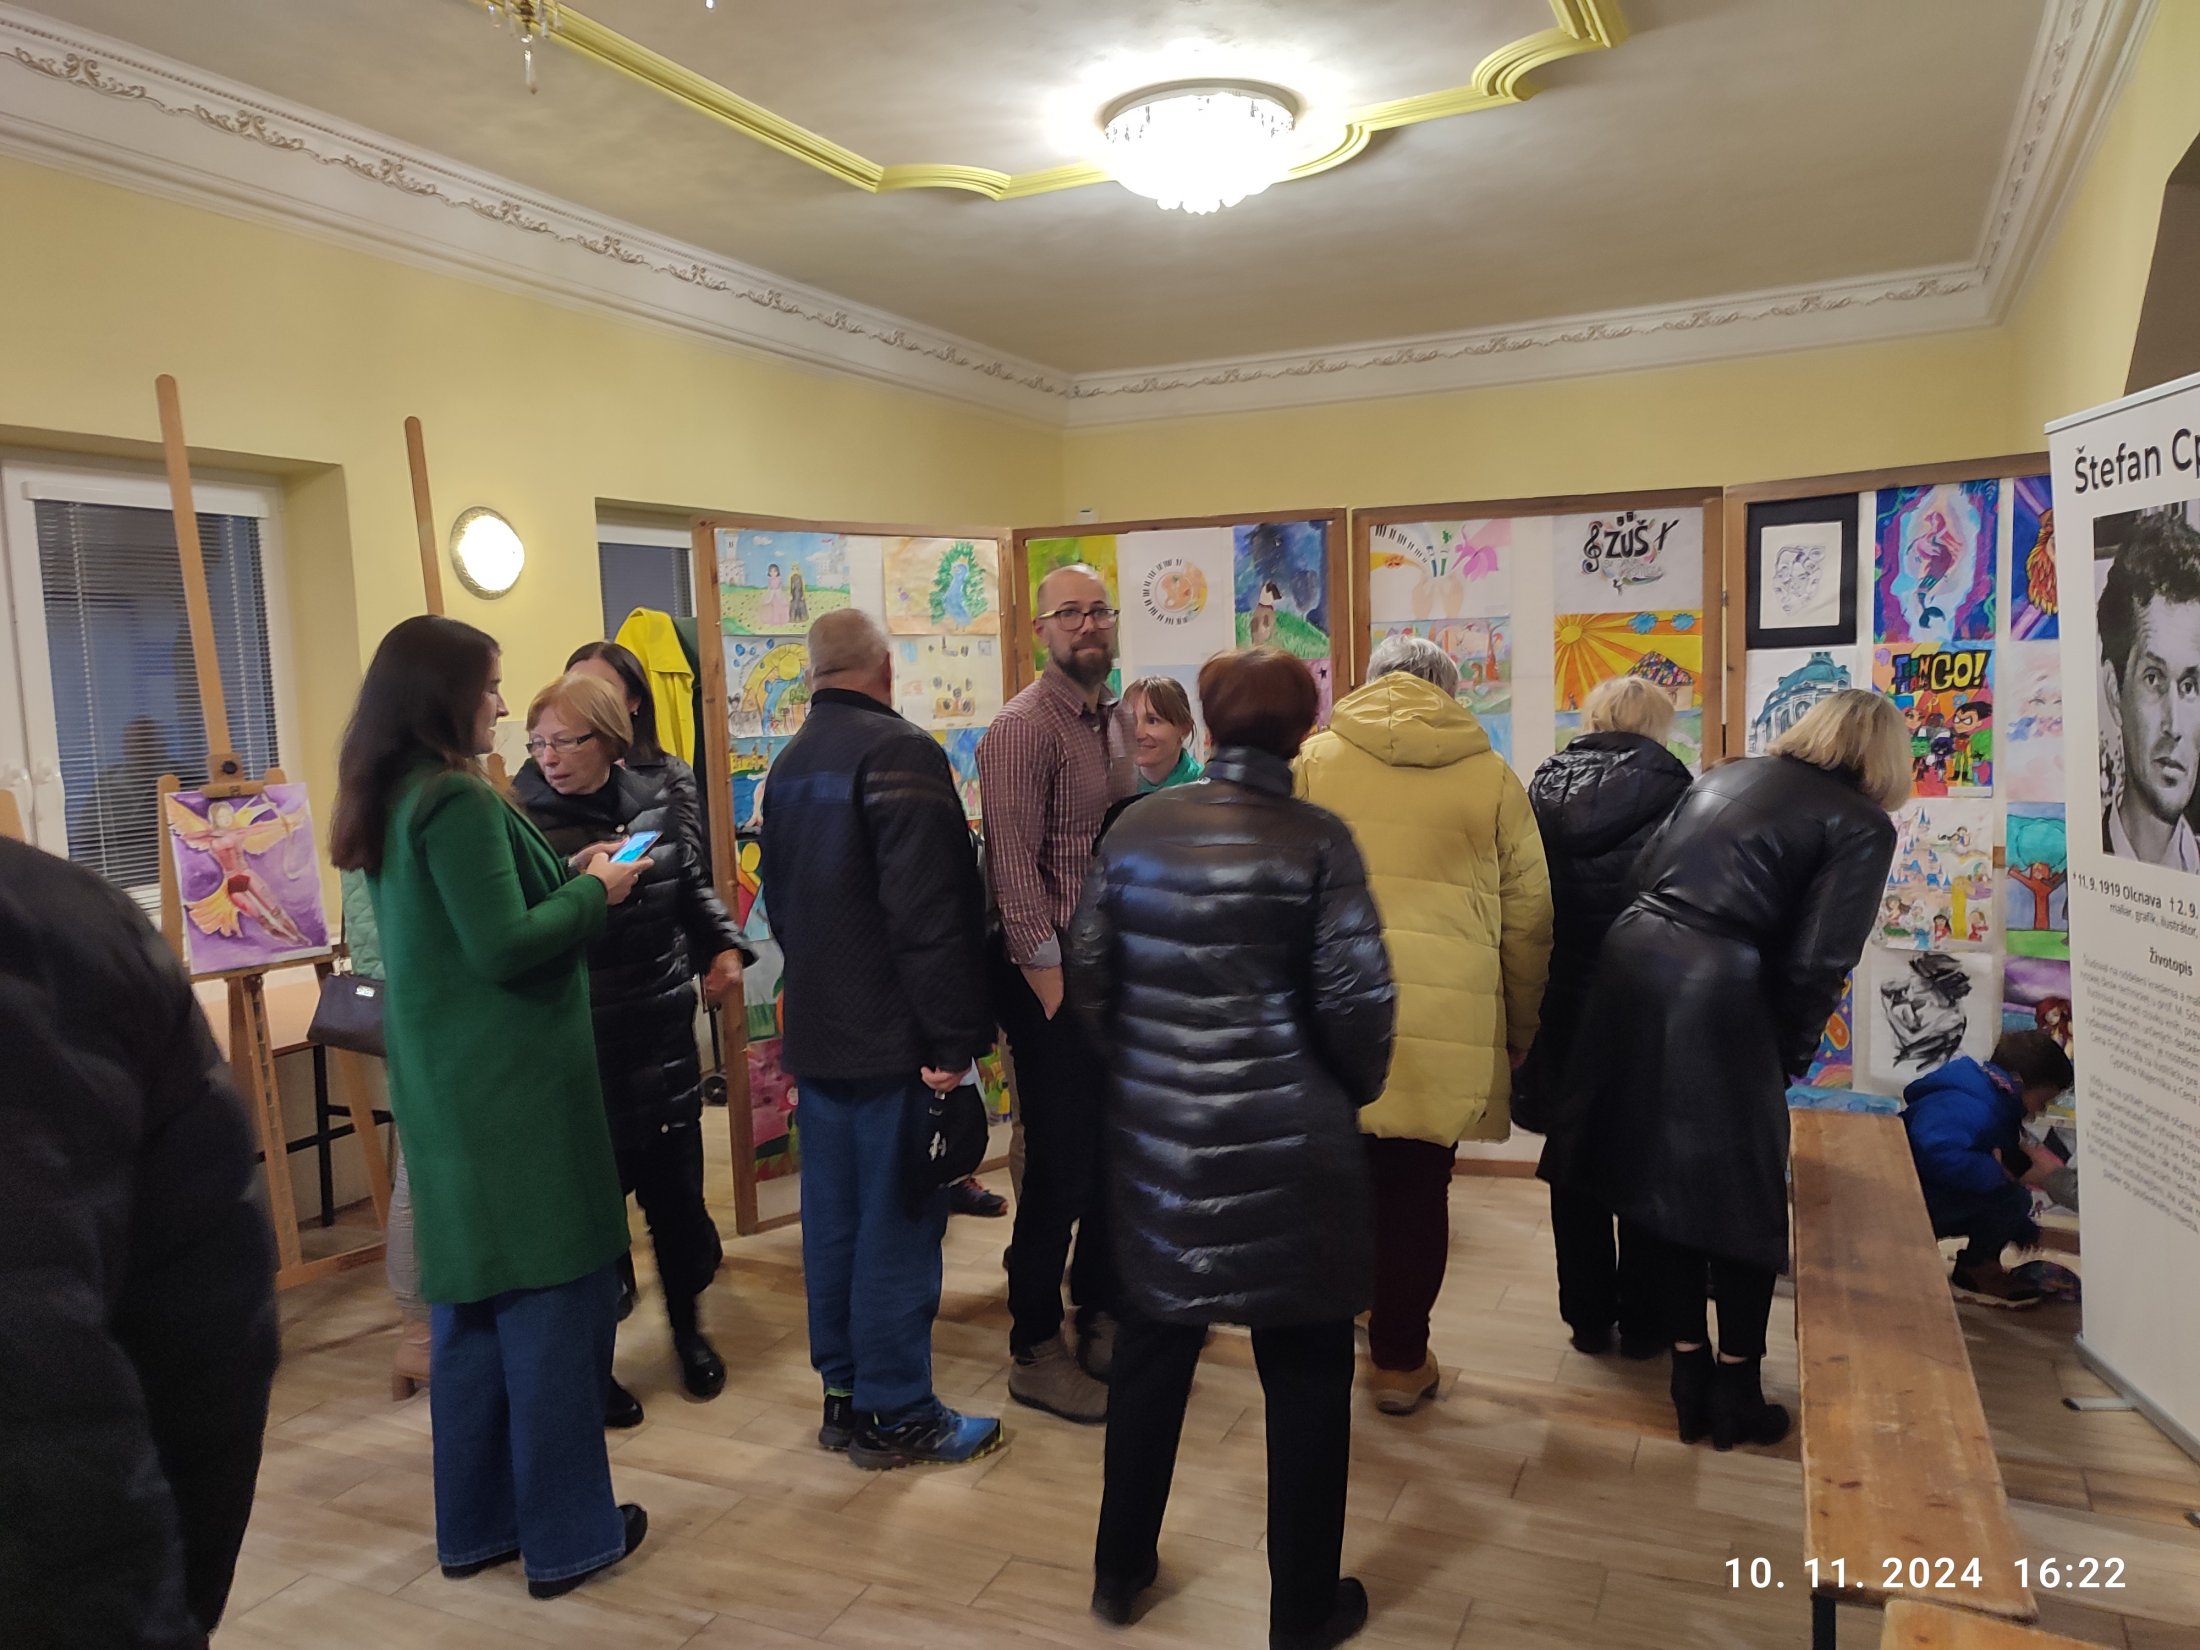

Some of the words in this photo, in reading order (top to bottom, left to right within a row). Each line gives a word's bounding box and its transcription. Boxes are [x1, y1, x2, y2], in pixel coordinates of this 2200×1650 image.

[2074, 442, 2162, 494] Štefan
[1603, 519, 1649, 559] ZUŠ
[1930, 651, 1987, 691] GO!
[2099, 879, 2121, 897] 1919
[2122, 885, 2162, 909] Olcnava
[2148, 946, 2193, 977] Životopis
